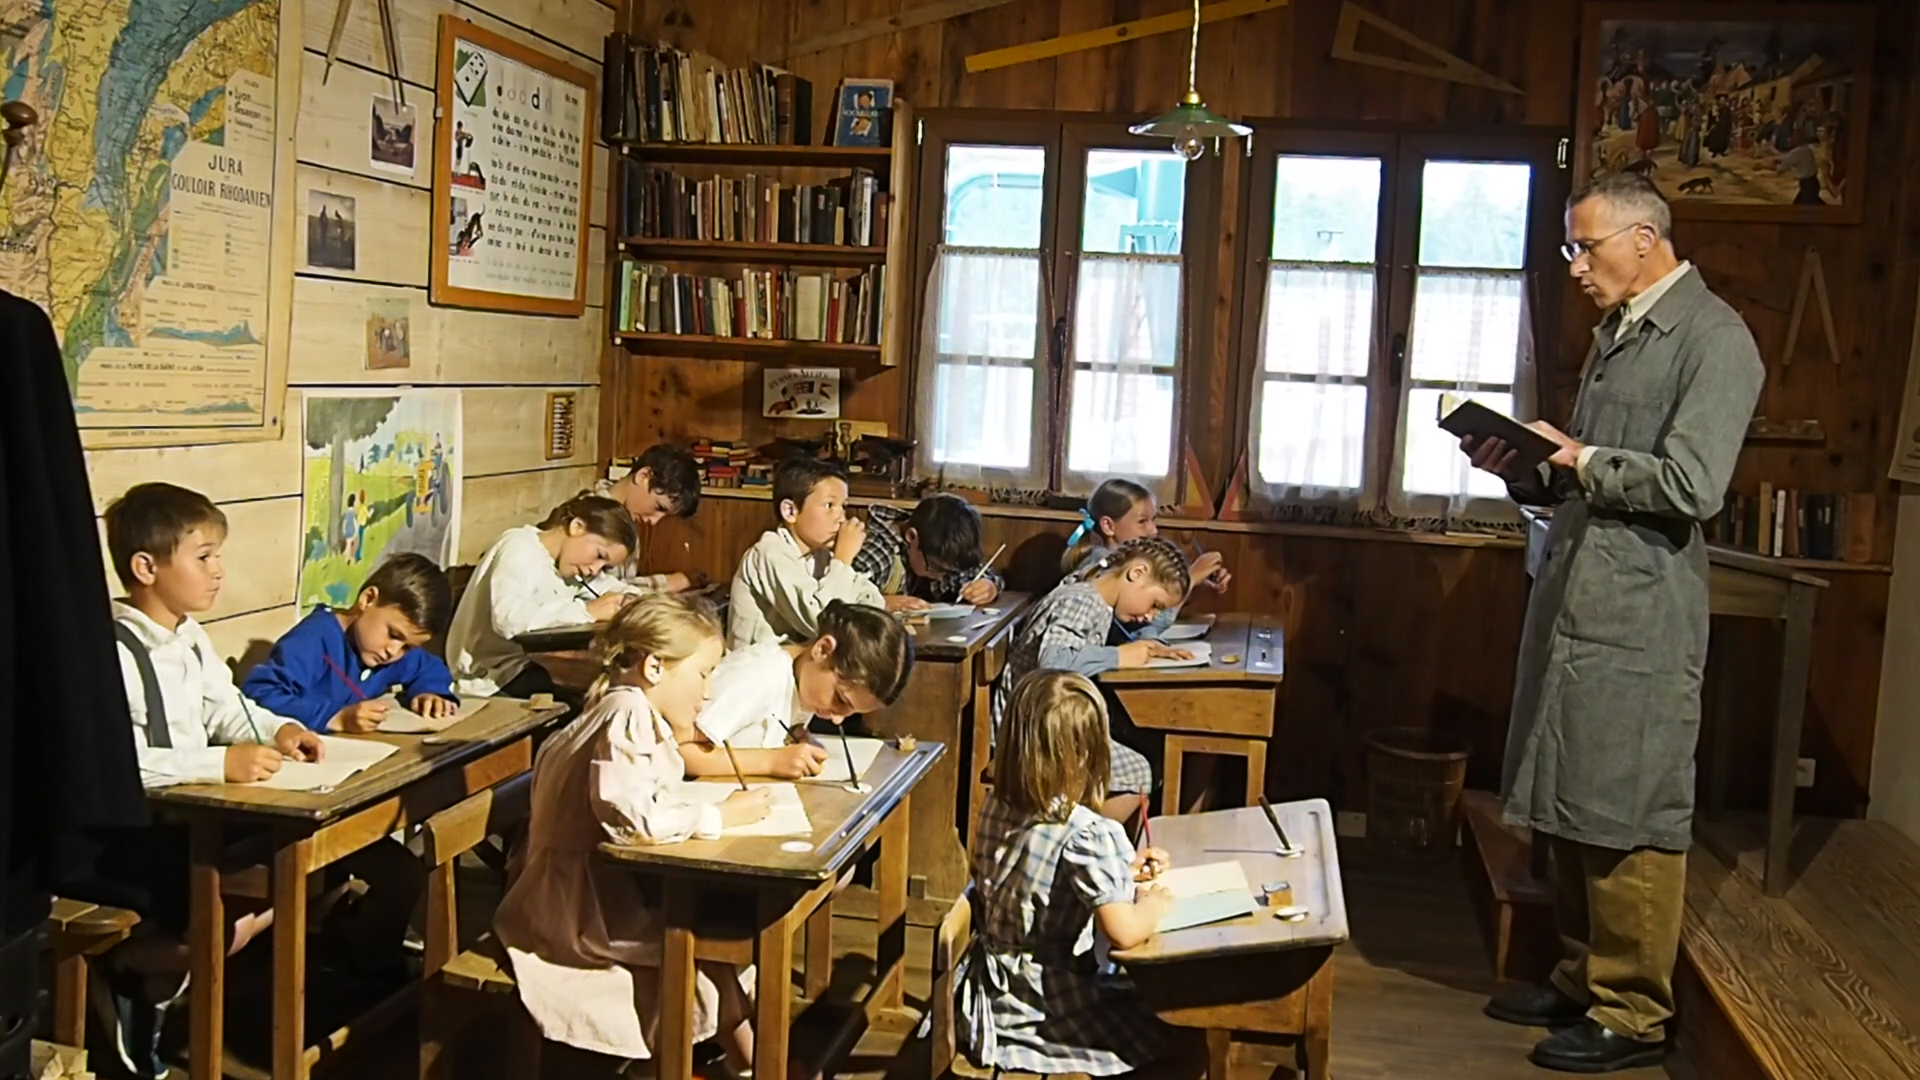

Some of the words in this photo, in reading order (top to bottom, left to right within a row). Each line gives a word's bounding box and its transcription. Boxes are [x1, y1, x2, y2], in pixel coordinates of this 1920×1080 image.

[208, 154, 243, 176] JURA
[172, 173, 216, 198] COULOIR
[219, 182, 271, 208] RHODANIEN
